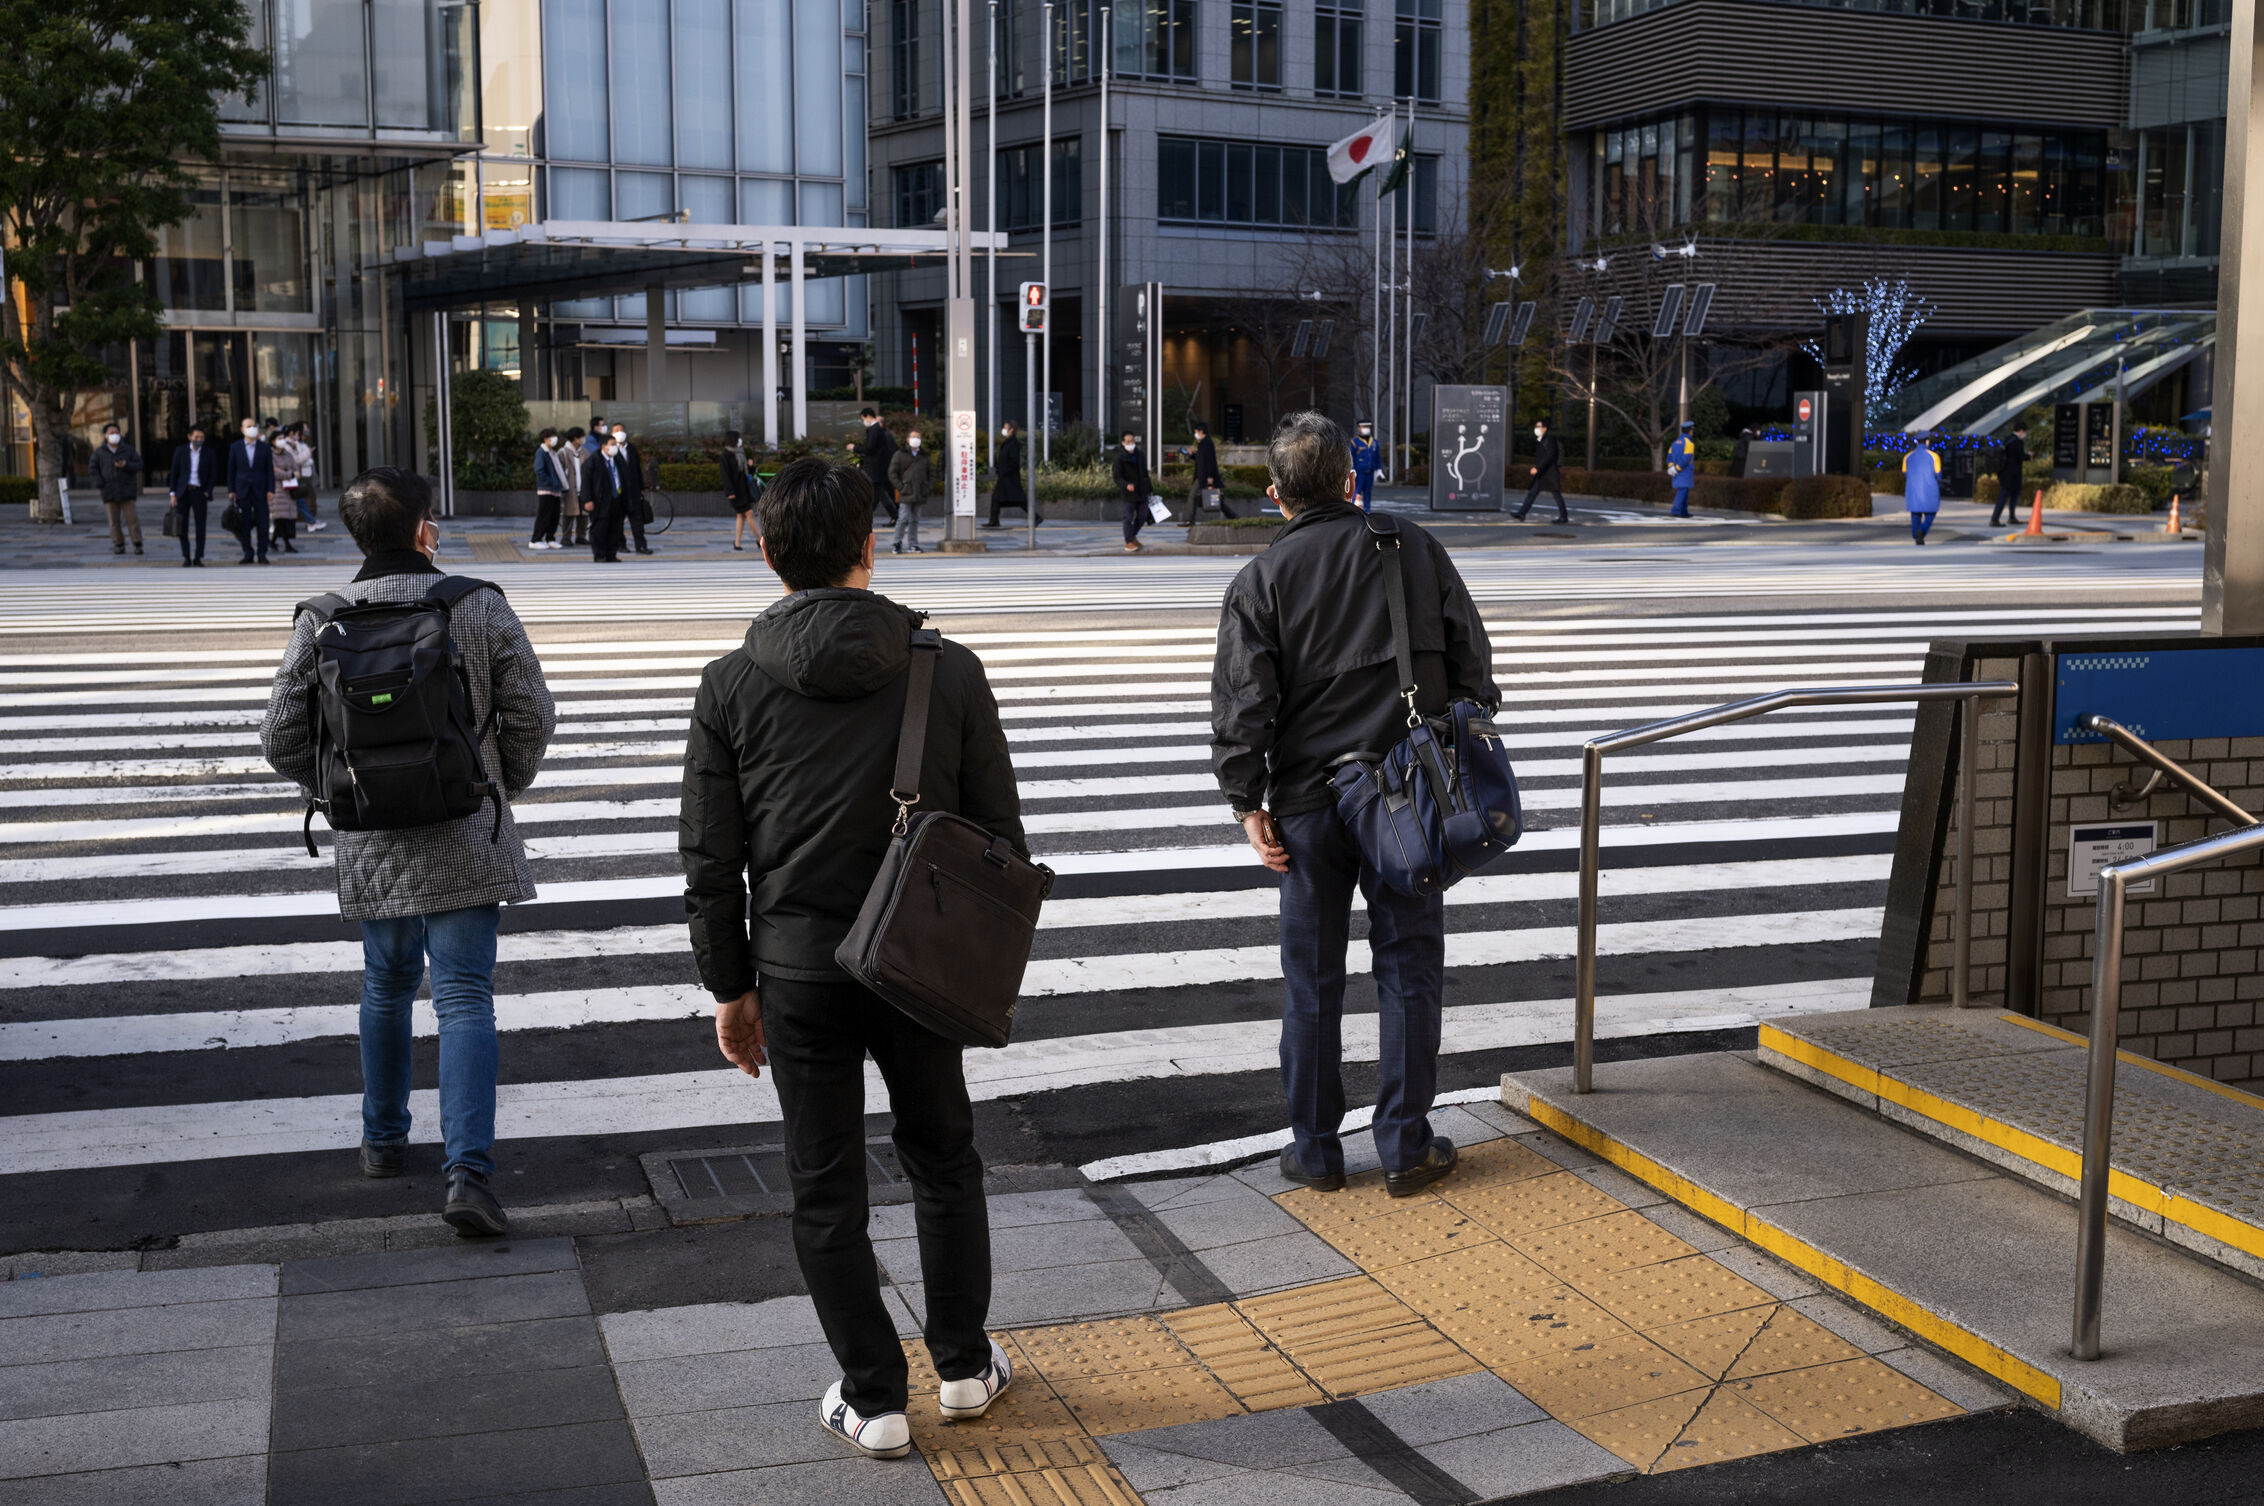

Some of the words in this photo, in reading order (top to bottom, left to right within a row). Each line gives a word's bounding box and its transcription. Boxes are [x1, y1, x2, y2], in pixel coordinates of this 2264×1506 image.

[1459, 424, 1466, 434] P
[1481, 424, 1488, 434] P
[2117, 842, 2135, 851] 4:00
